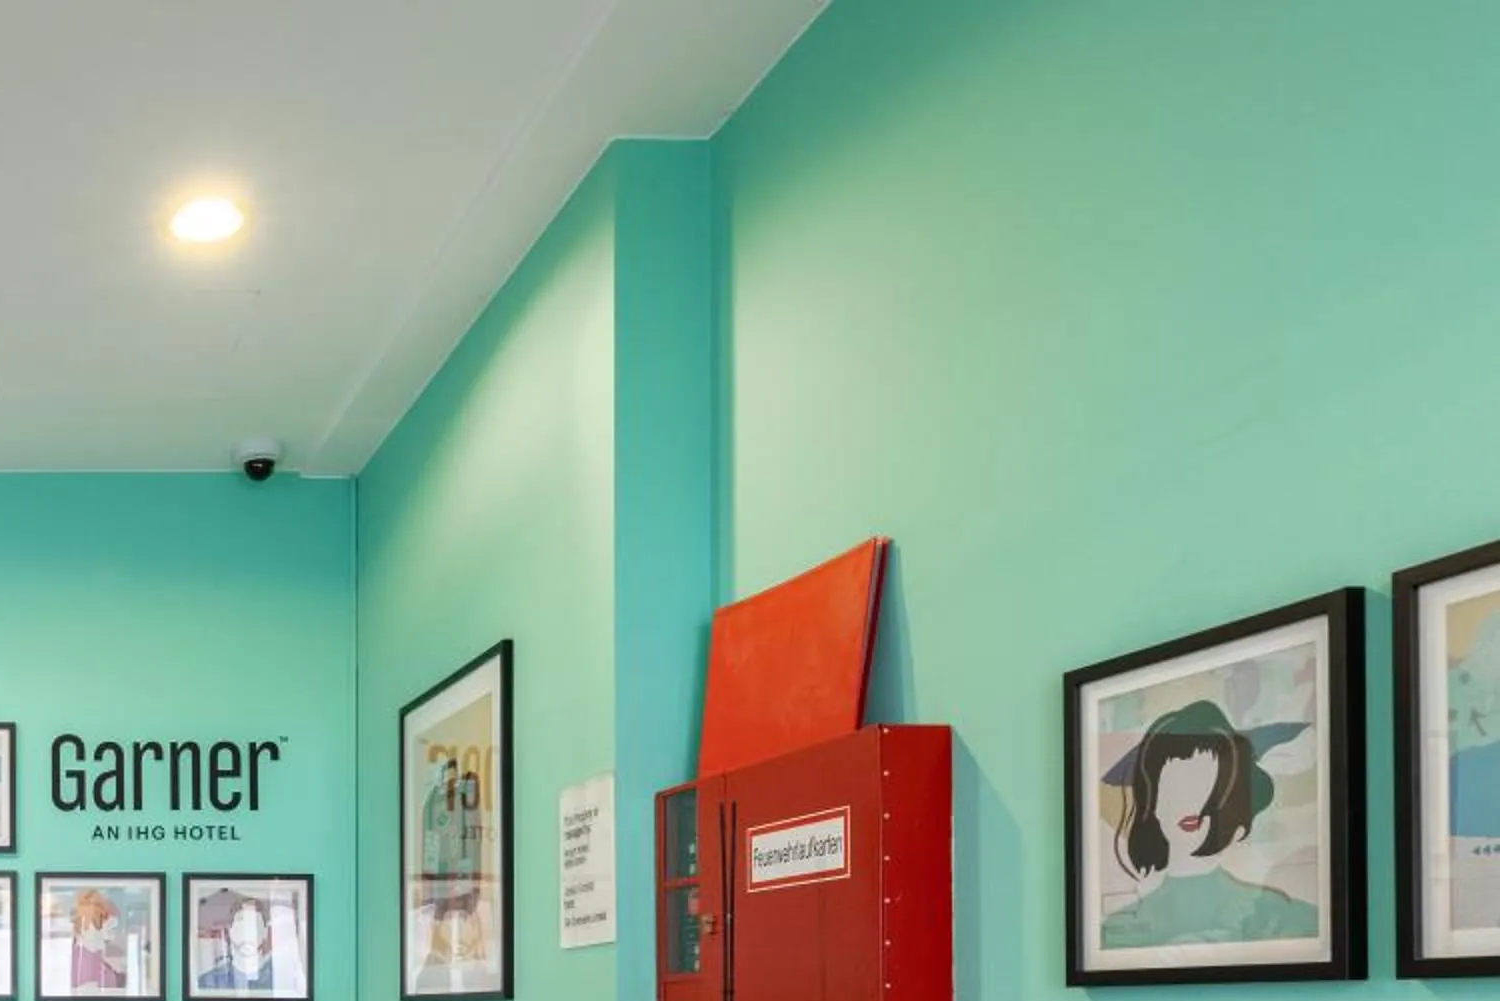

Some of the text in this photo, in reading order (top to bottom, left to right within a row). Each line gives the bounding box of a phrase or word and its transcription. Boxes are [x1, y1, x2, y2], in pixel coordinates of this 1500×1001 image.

[51, 733, 280, 812] Garner
[92, 825, 240, 841] AN IHG HOTEL
